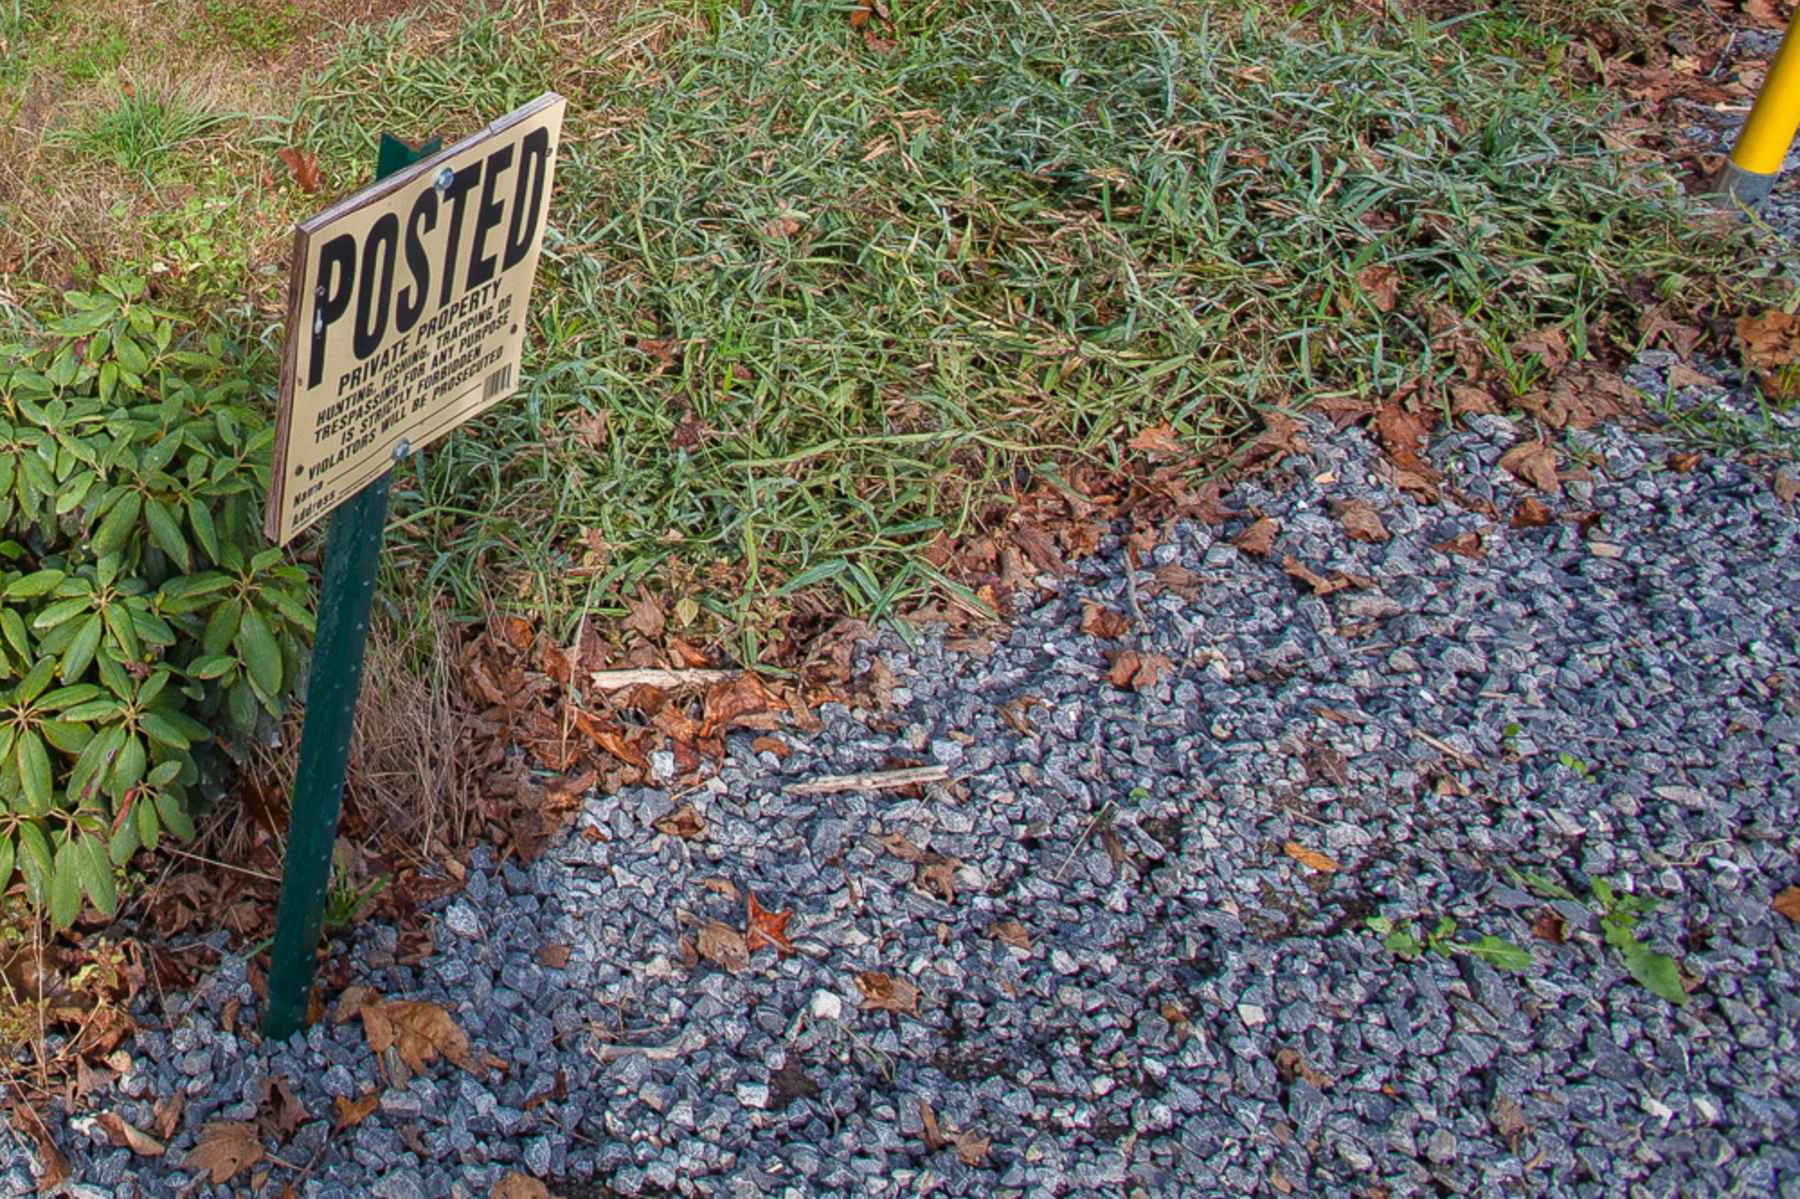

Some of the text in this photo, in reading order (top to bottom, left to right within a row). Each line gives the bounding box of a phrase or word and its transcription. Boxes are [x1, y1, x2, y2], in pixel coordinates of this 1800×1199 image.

[307, 125, 550, 391] POSTED
[338, 278, 503, 395] PRIVATE PROPERTY
[436, 309, 493, 349] TRAPPING
[498, 294, 513, 312] OR
[308, 345, 504, 481] VIOLATORS WILL BE PROSECUTED
[314, 311, 510, 443] TRESPASSING FOR ANY PURPOSE
[340, 344, 482, 446] IS STRICTLY FORBIDDEN
[292, 480, 324, 507] Name
[292, 489, 337, 527] Address
